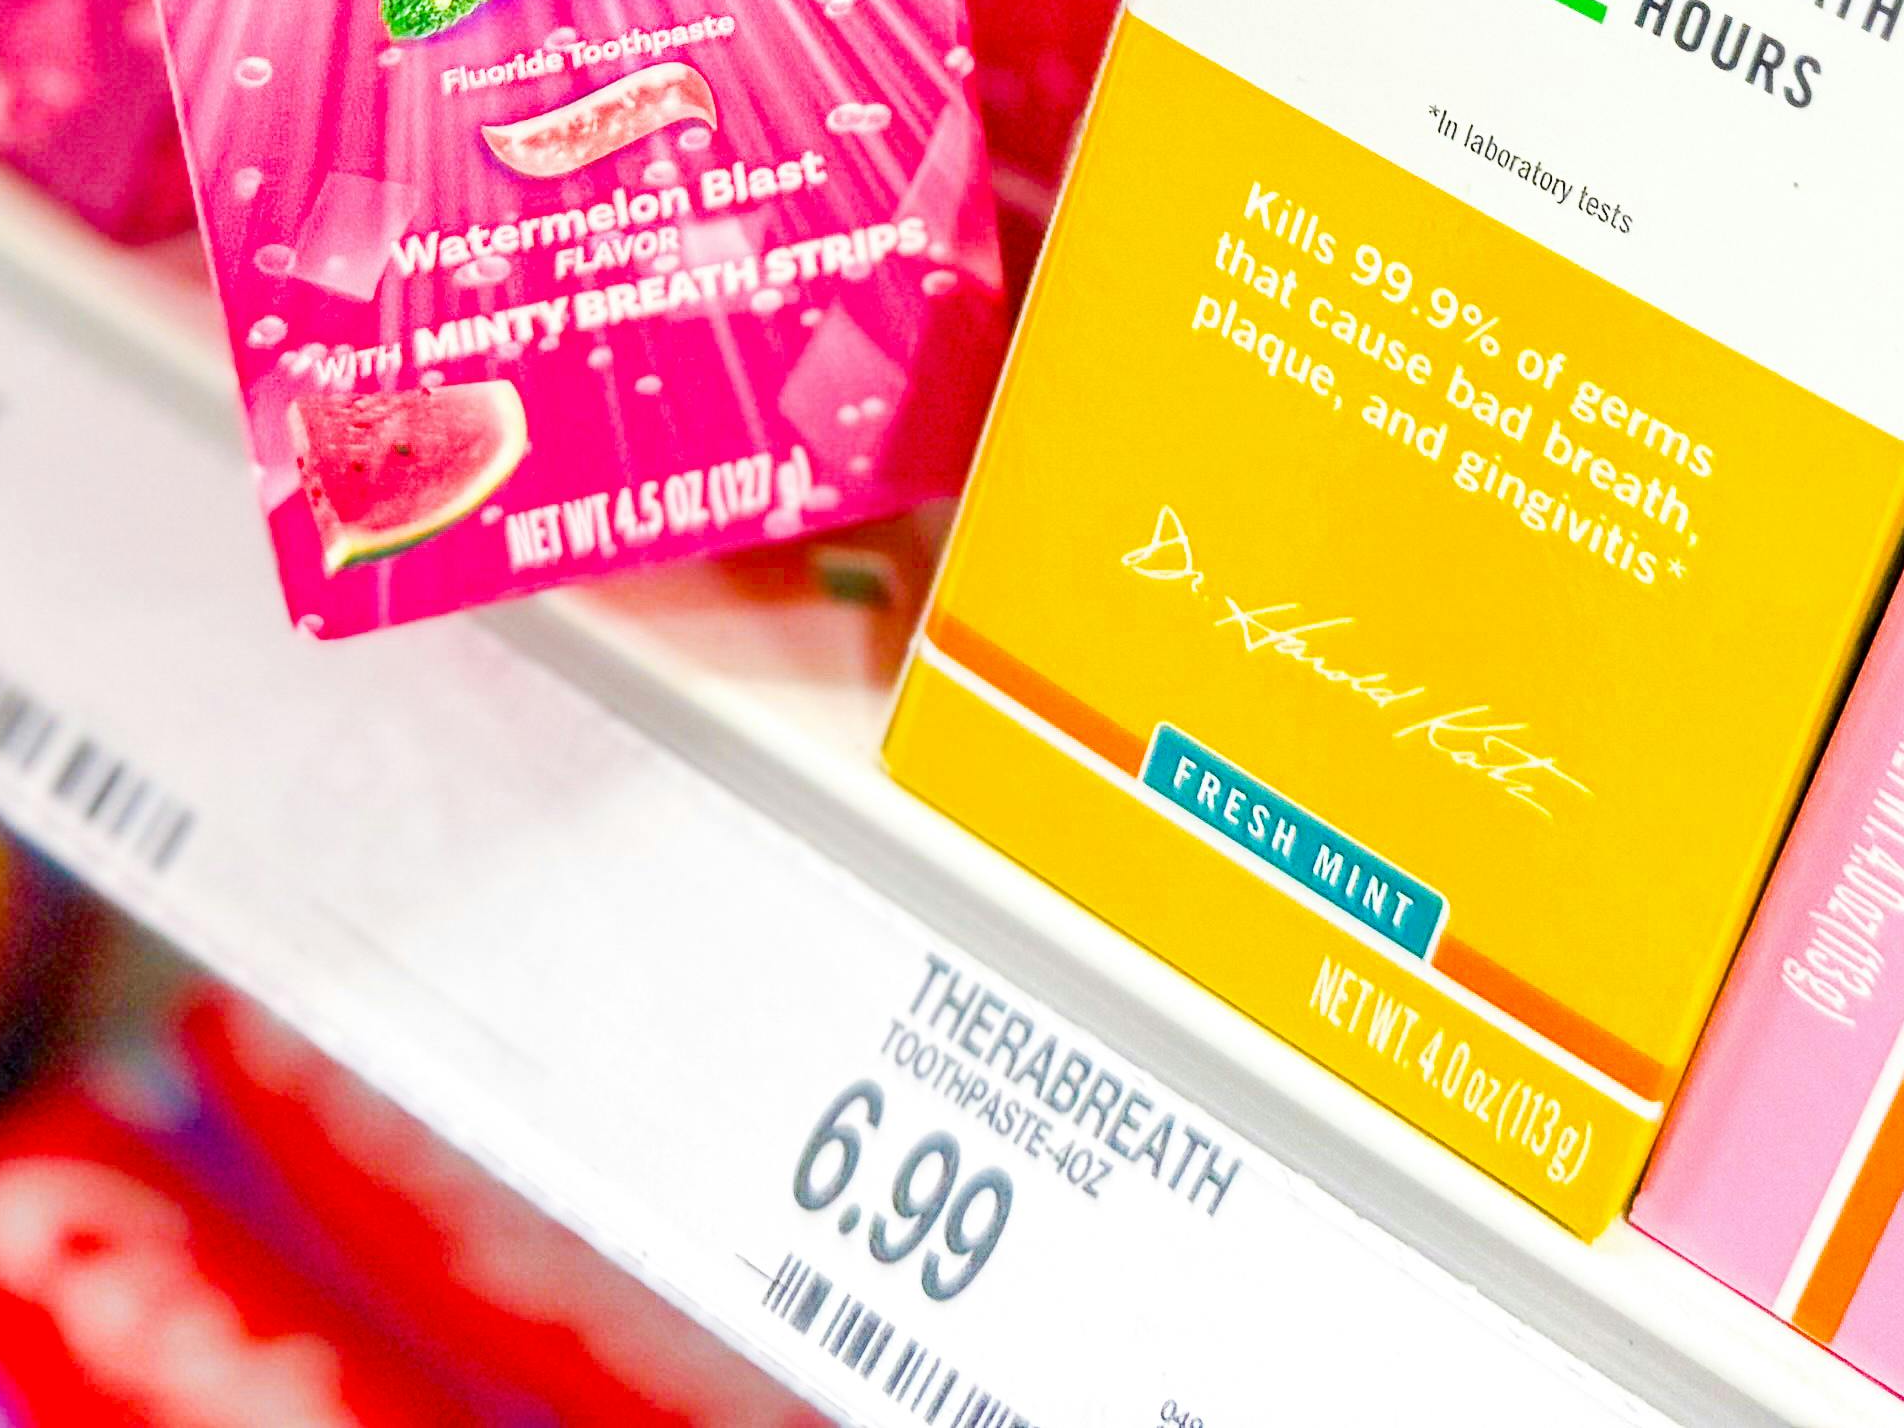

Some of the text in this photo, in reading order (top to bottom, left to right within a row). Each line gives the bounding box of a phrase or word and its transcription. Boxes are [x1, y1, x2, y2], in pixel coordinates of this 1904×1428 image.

[442, 12, 735, 94] Fluoride Toothpaste
[389, 150, 827, 277] Watermelon Blast
[554, 227, 678, 277] FLAVOR
[1464, 119, 1572, 205] laboratory
[1578, 183, 1633, 235] tests
[317, 220, 927, 386] WITH MINTY BREATH STRIPS
[1191, 291, 1345, 411] plaque,
[1361, 392, 1444, 462] and
[1243, 180, 1716, 480] Kills 99.9% of germs
[1212, 233, 1701, 546] that cause bad breath,
[506, 504, 563, 572] NET
[615, 481, 664, 543] 4.5
[664, 470, 709, 534] OZ
[1172, 753, 1416, 933] FRESH MINT
[880, 1019, 1115, 1199] TOOTHPASTE-4OZ
[907, 951, 1242, 1217] THERABREATH
[1310, 955, 1374, 1032] NET
[1368, 989, 1419, 1069] WT.
[1418, 1029, 1470, 1099] 4.0
[1464, 1069, 1501, 1123] oz
[794, 1078, 1014, 1302] 6.99
